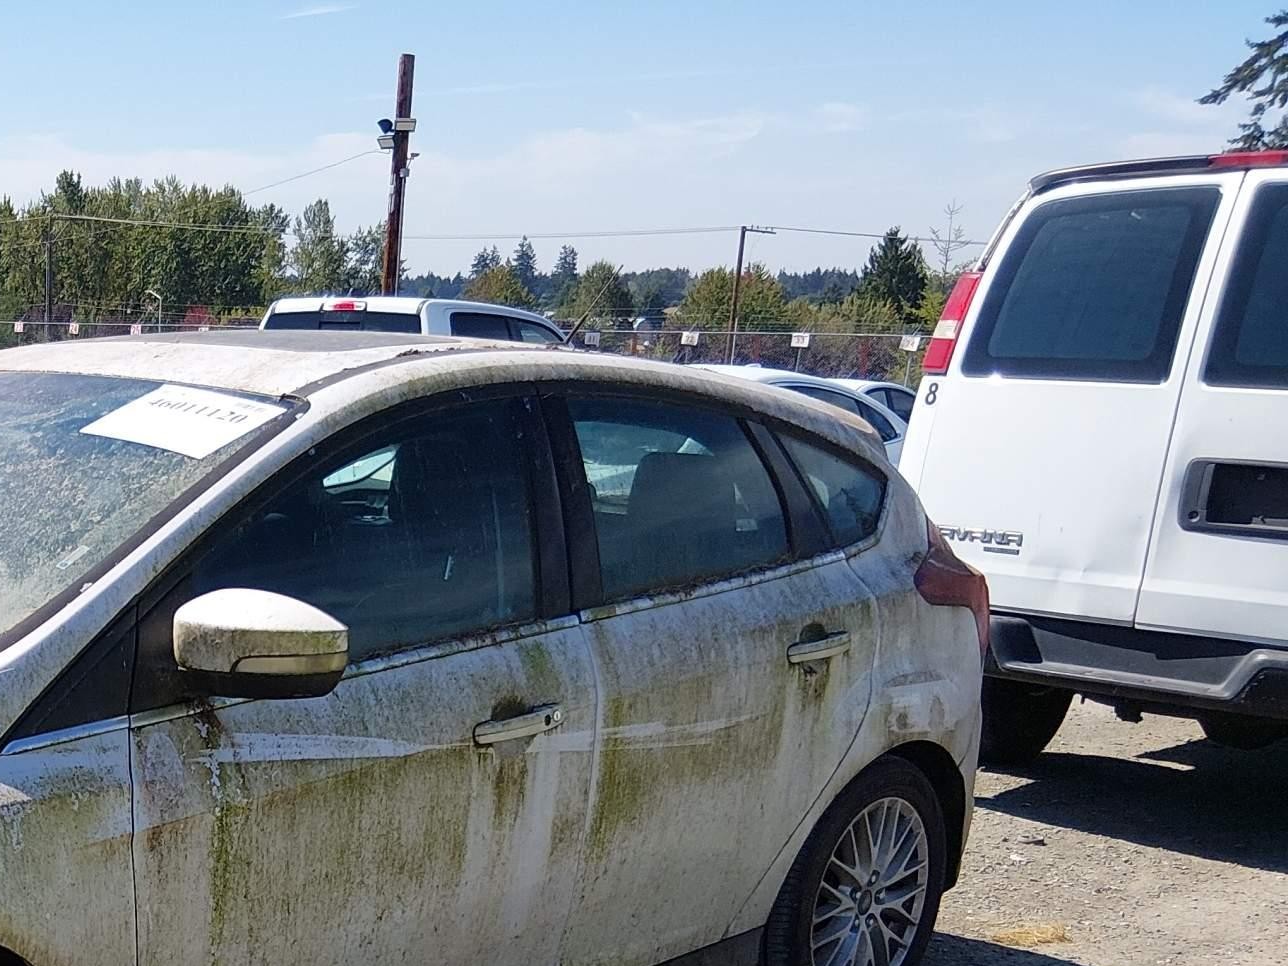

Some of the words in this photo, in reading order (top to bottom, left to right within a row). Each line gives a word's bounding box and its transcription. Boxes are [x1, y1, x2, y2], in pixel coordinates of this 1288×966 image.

[925, 382, 939, 406] 8
[149, 398, 249, 424] 46011120
[936, 526, 1023, 547] AVANA
